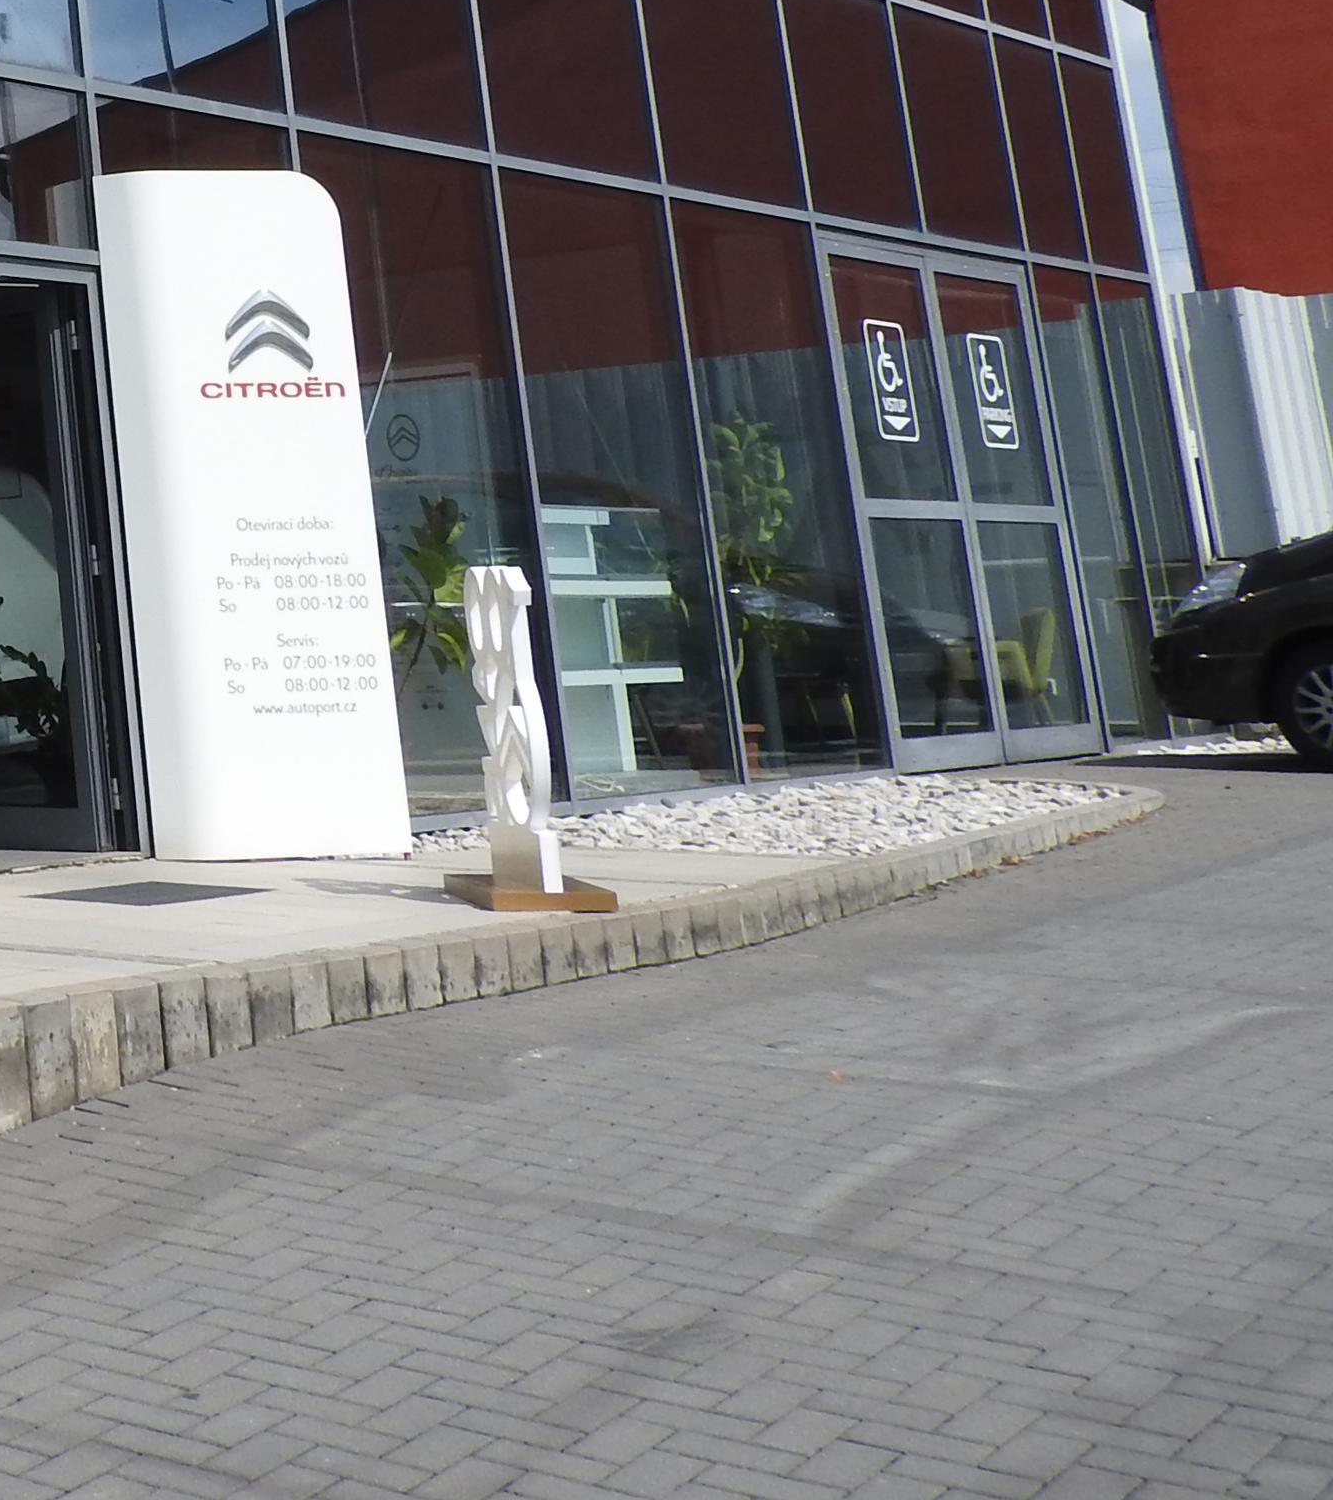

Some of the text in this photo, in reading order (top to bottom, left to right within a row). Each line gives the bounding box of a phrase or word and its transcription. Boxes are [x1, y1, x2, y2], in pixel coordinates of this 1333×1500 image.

[230, 552, 271, 570] Prodej
[216, 575, 234, 590] Po
[218, 598, 237, 613] So
[223, 657, 242, 671] Po
[227, 680, 245, 694] So
[253, 702, 357, 717] www.autoport.cz
